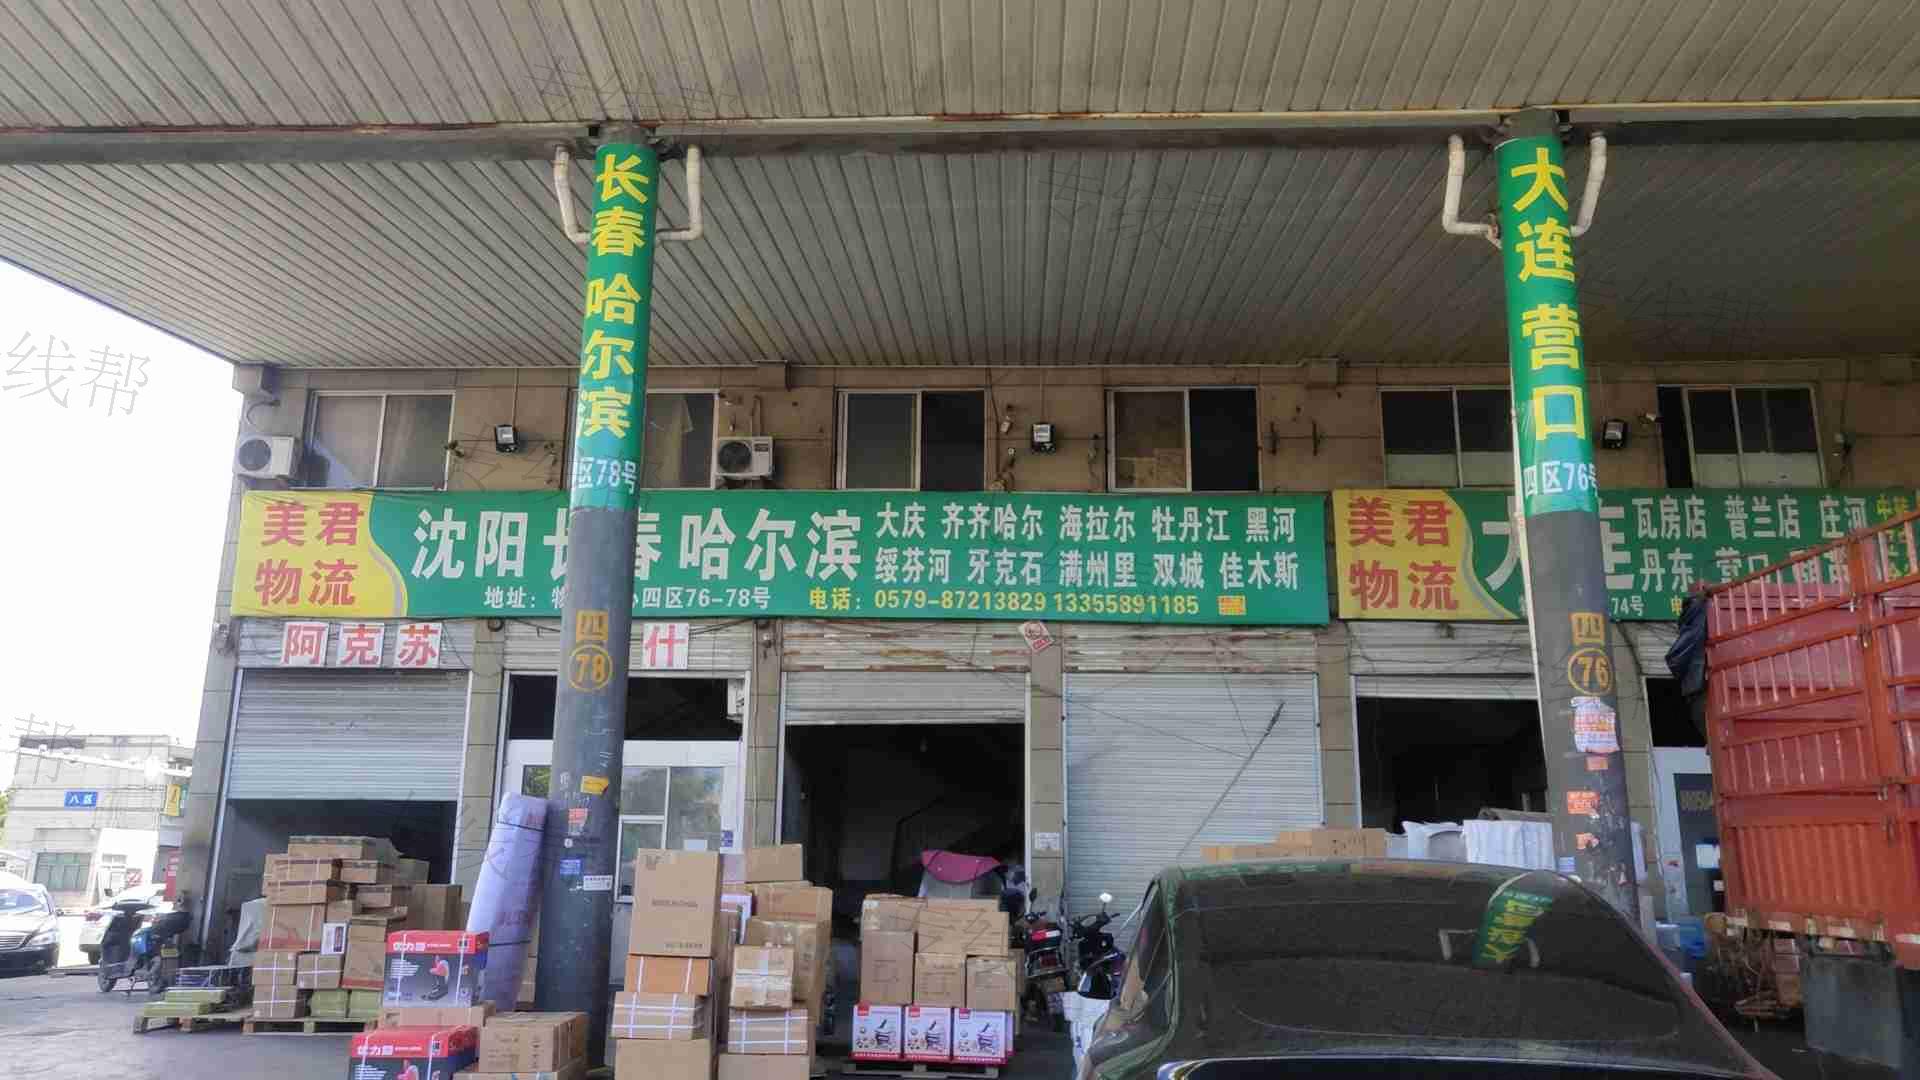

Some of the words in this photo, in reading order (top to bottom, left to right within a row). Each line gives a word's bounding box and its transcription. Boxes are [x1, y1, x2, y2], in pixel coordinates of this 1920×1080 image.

[591, 153, 649, 257] 长春
[1511, 147, 1576, 283] 大连
[577, 273, 641, 439] 哈尔滨
[1521, 303, 1586, 441] 营口
[261, 501, 364, 547] 美君
[875, 501, 926, 539] 大庆
[942, 502, 1044, 540] 齐齐哈尔
[1059, 505, 1135, 543] 海拉尔
[1151, 506, 1230, 543] 牡丹江
[1246, 506, 1296, 544] 黑河
[1347, 497, 1454, 547] 美君
[1631, 495, 1707, 540] 瓦房店
[1723, 494, 1801, 540] 普兰店
[1819, 495, 1868, 539] 庄河
[254, 559, 358, 608] 物流
[875, 545, 951, 585] 绥芬河
[967, 548, 1043, 587] 牙克石
[1059, 549, 1138, 589] 满州里
[1152, 551, 1204, 589] 双城
[1219, 551, 1299, 591] 佳木斯
[1349, 559, 1460, 611] 物流
[1639, 547, 1694, 593] 丹东
[576, 609, 608, 641] 四
[1053, 593, 1200, 616] 13355891185
[281, 623, 439, 667] 阿克苏
[643, 623, 687, 667] 什
[1570, 612, 1606, 645] 四
[575, 655, 606, 683] 78
[1577, 655, 1610, 689] 76
